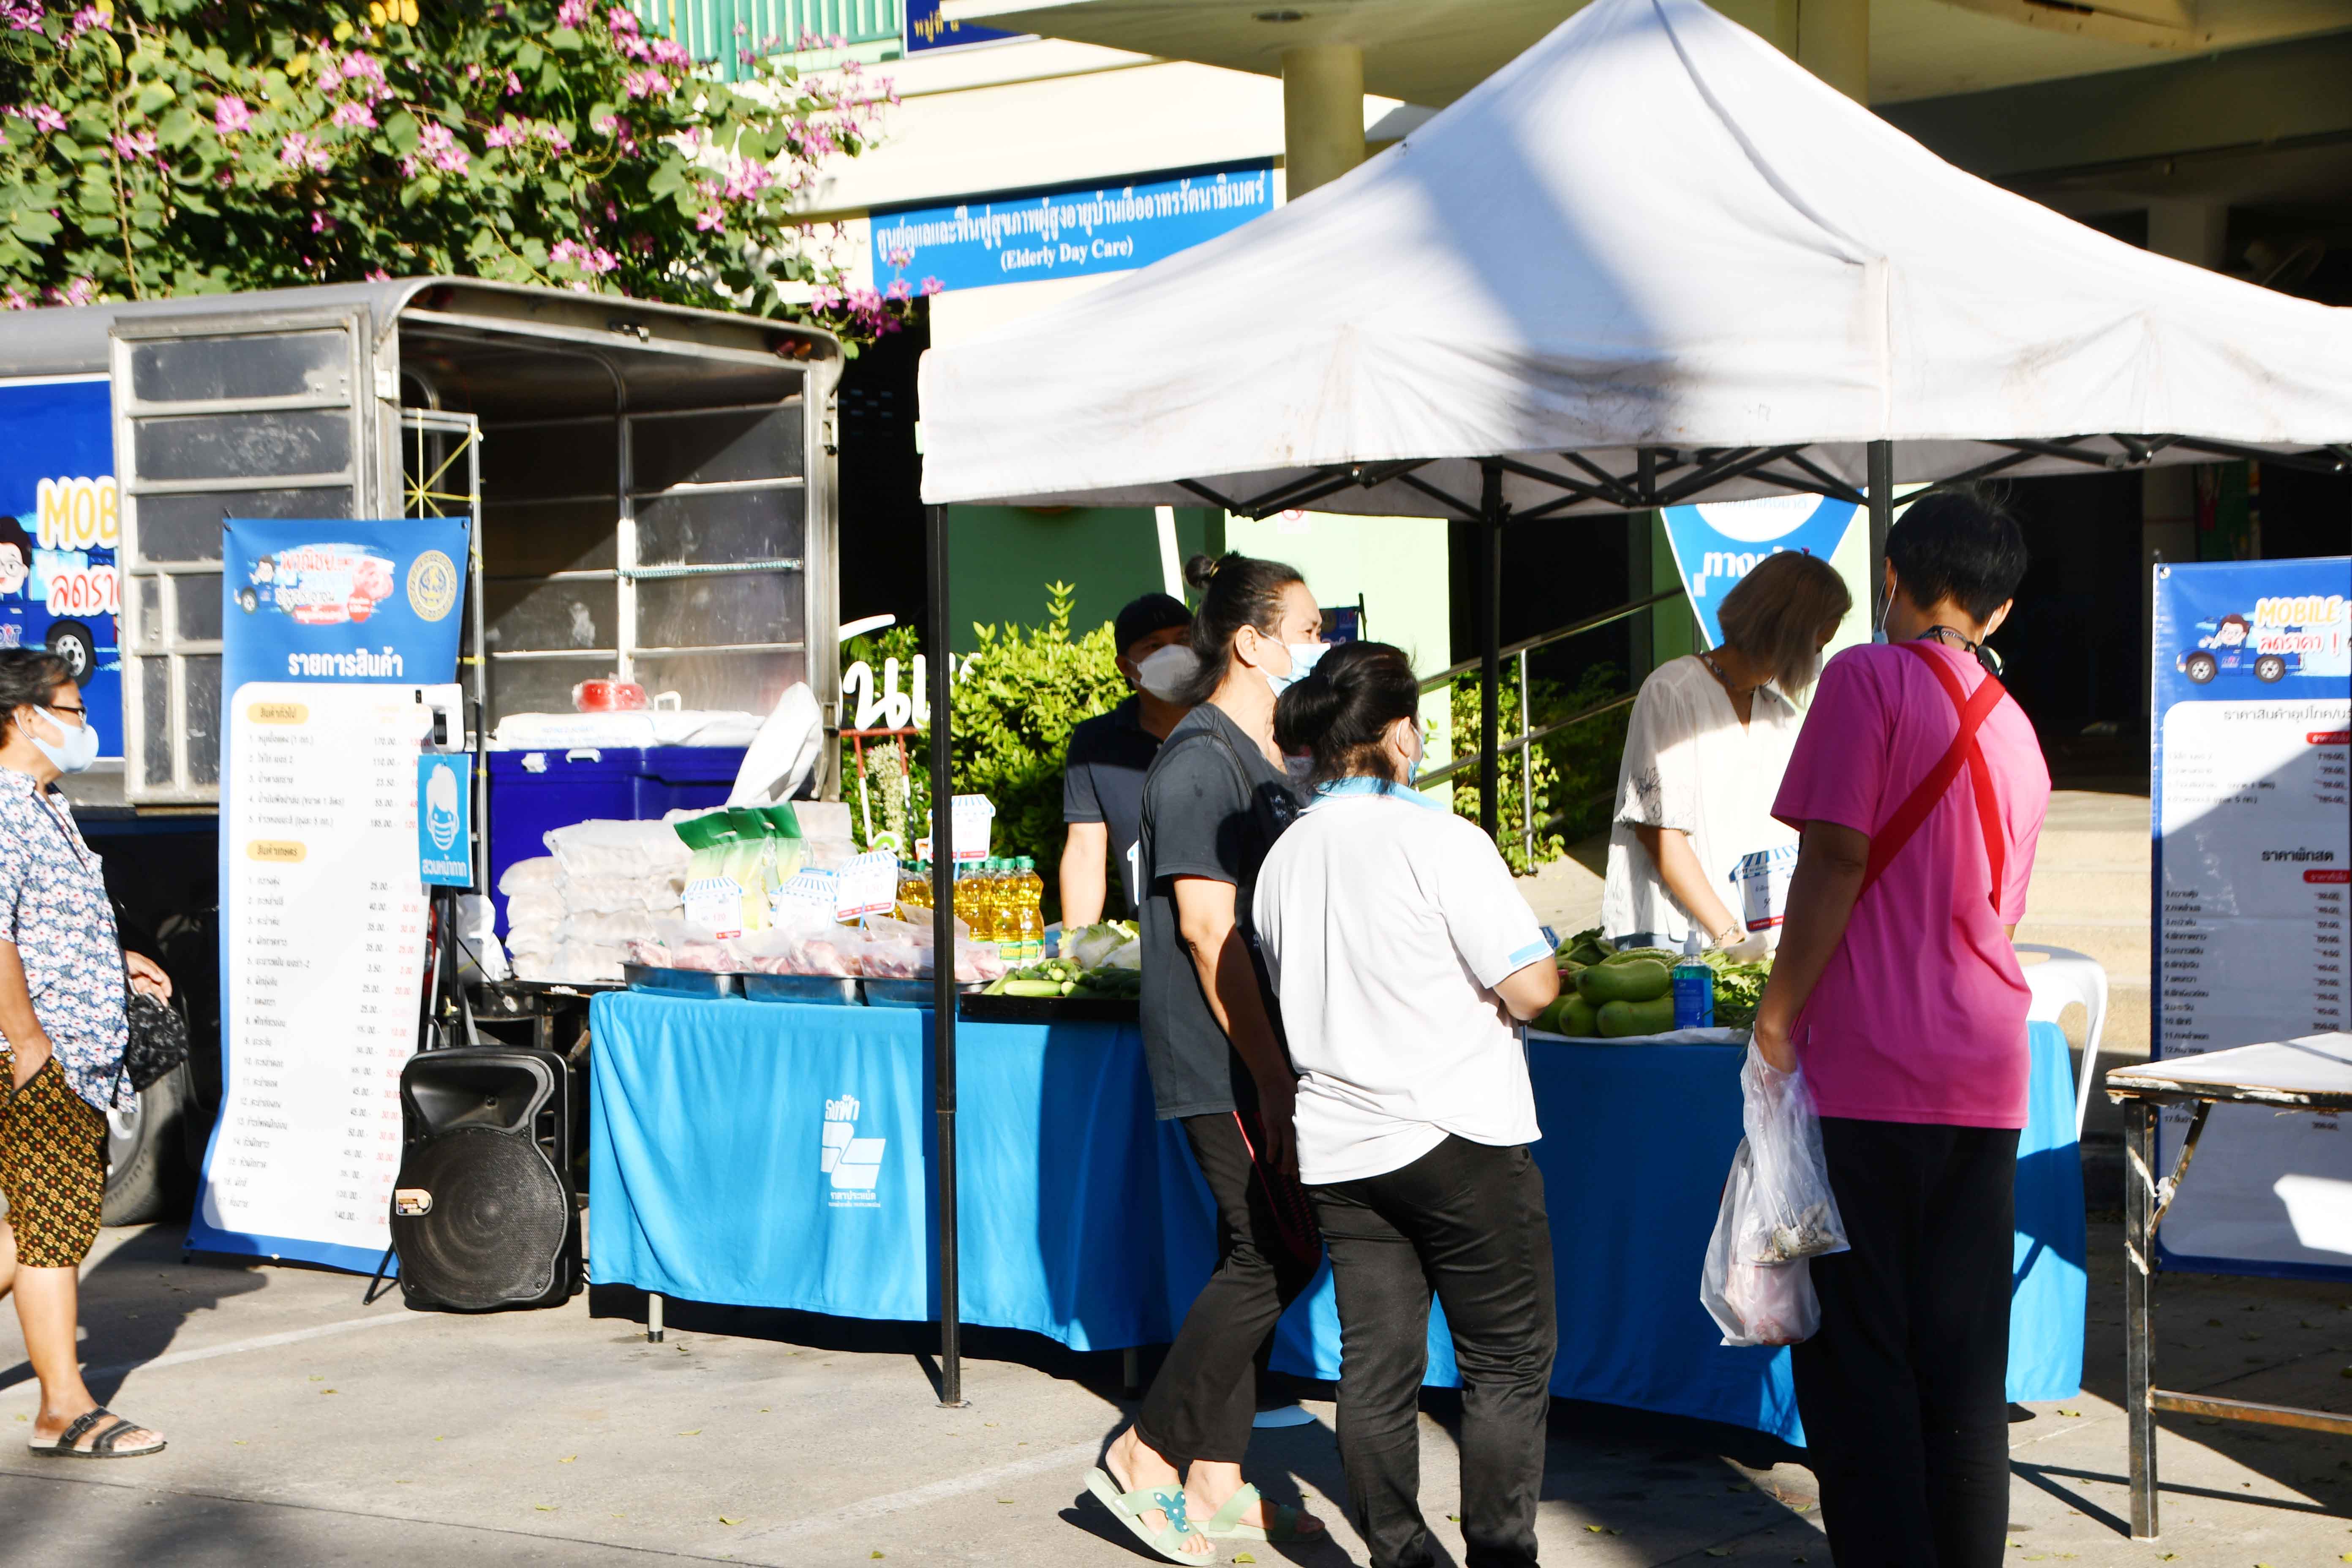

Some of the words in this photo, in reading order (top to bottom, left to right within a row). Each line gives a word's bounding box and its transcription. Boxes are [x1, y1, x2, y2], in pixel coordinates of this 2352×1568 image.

[1001, 245, 1056, 272] (Elderly
[1059, 238, 1089, 265] Day
[1091, 235, 1133, 260] Care)
[2257, 601, 2338, 624] MOBILE
[2259, 635, 2322, 650] ลดราคา
[289, 647, 403, 676] รายการสินค้า
[422, 854, 467, 877] สวมหน้ากาก
[2262, 847, 2333, 862] ราคาผักสด
